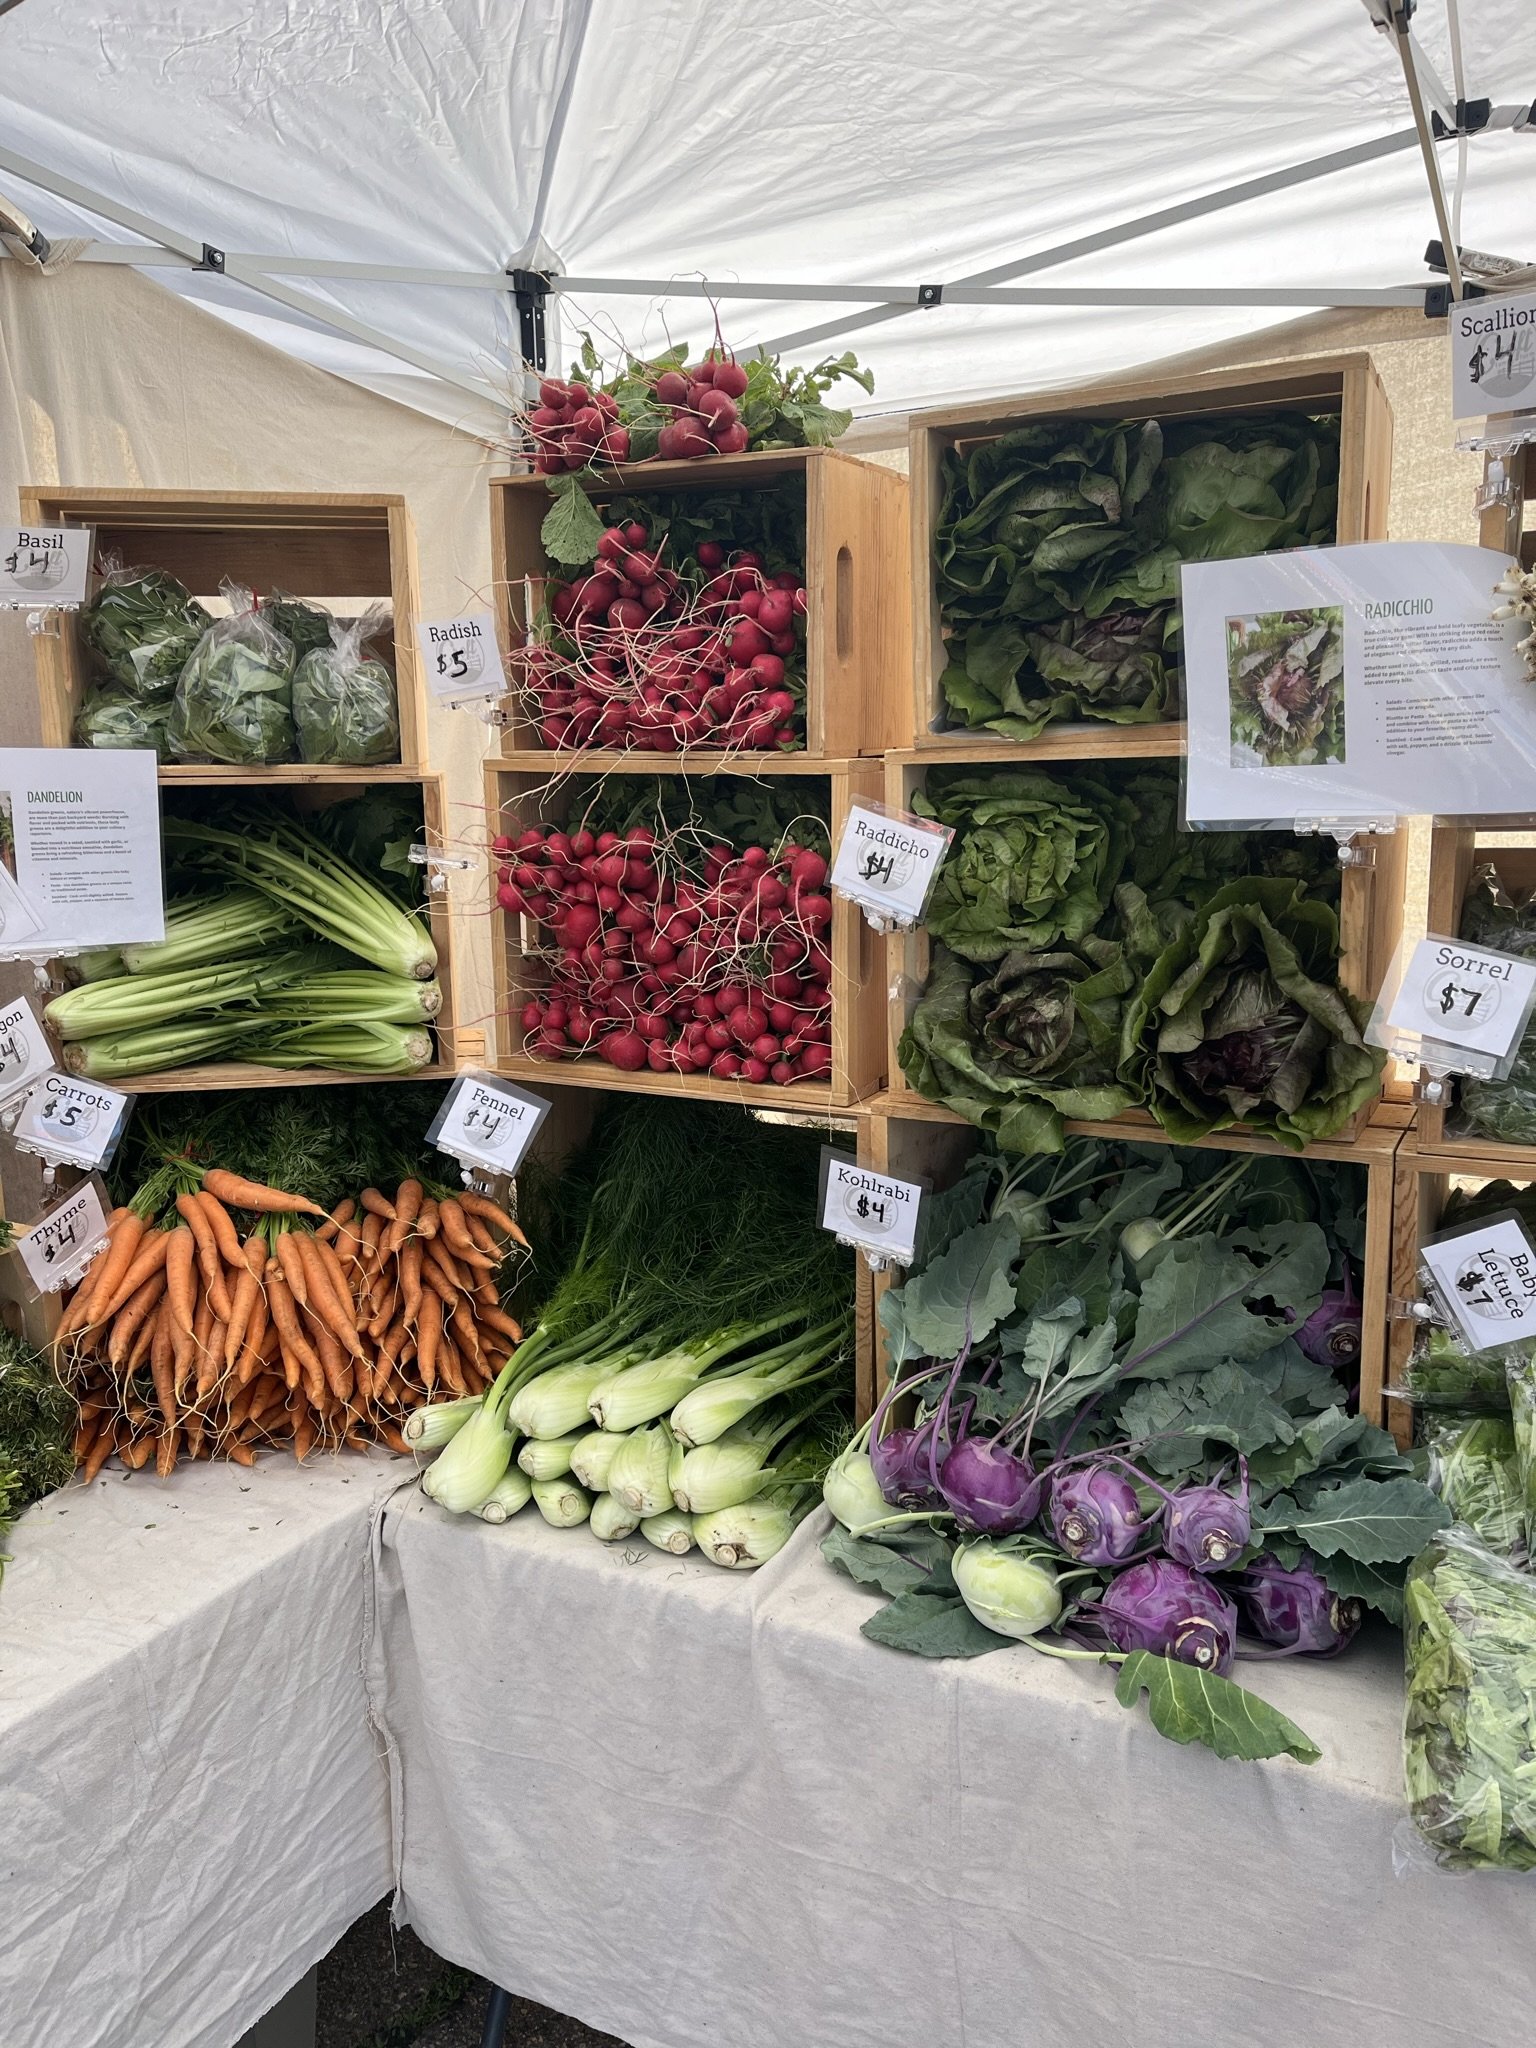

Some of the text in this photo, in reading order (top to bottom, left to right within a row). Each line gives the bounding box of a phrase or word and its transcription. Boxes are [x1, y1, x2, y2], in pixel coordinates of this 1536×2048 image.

[1469, 330, 1517, 383] $4
[17, 532, 64, 549] Basil
[1365, 599, 1433, 619] RADICCHIO
[428, 621, 482, 642] Radish
[437, 650, 468, 678] $5
[27, 791, 83, 802] DANDELION
[855, 821, 929, 858] Raddicho
[859, 852, 894, 883] $4
[1436, 947, 1513, 981] Sorrel
[1440, 982, 1482, 1017] $7
[46, 1078, 112, 1110] Carrots
[472, 1088, 525, 1120] Fennel
[42, 1100, 82, 1126] $5
[463, 1110, 501, 1139] $4
[838, 1168, 910, 1202] Kohlrabi
[30, 1199, 87, 1245] Thyme
[857, 1194, 884, 1222] $4
[45, 1224, 75, 1263] $4
[1478, 1248, 1524, 1319] Lettuce
